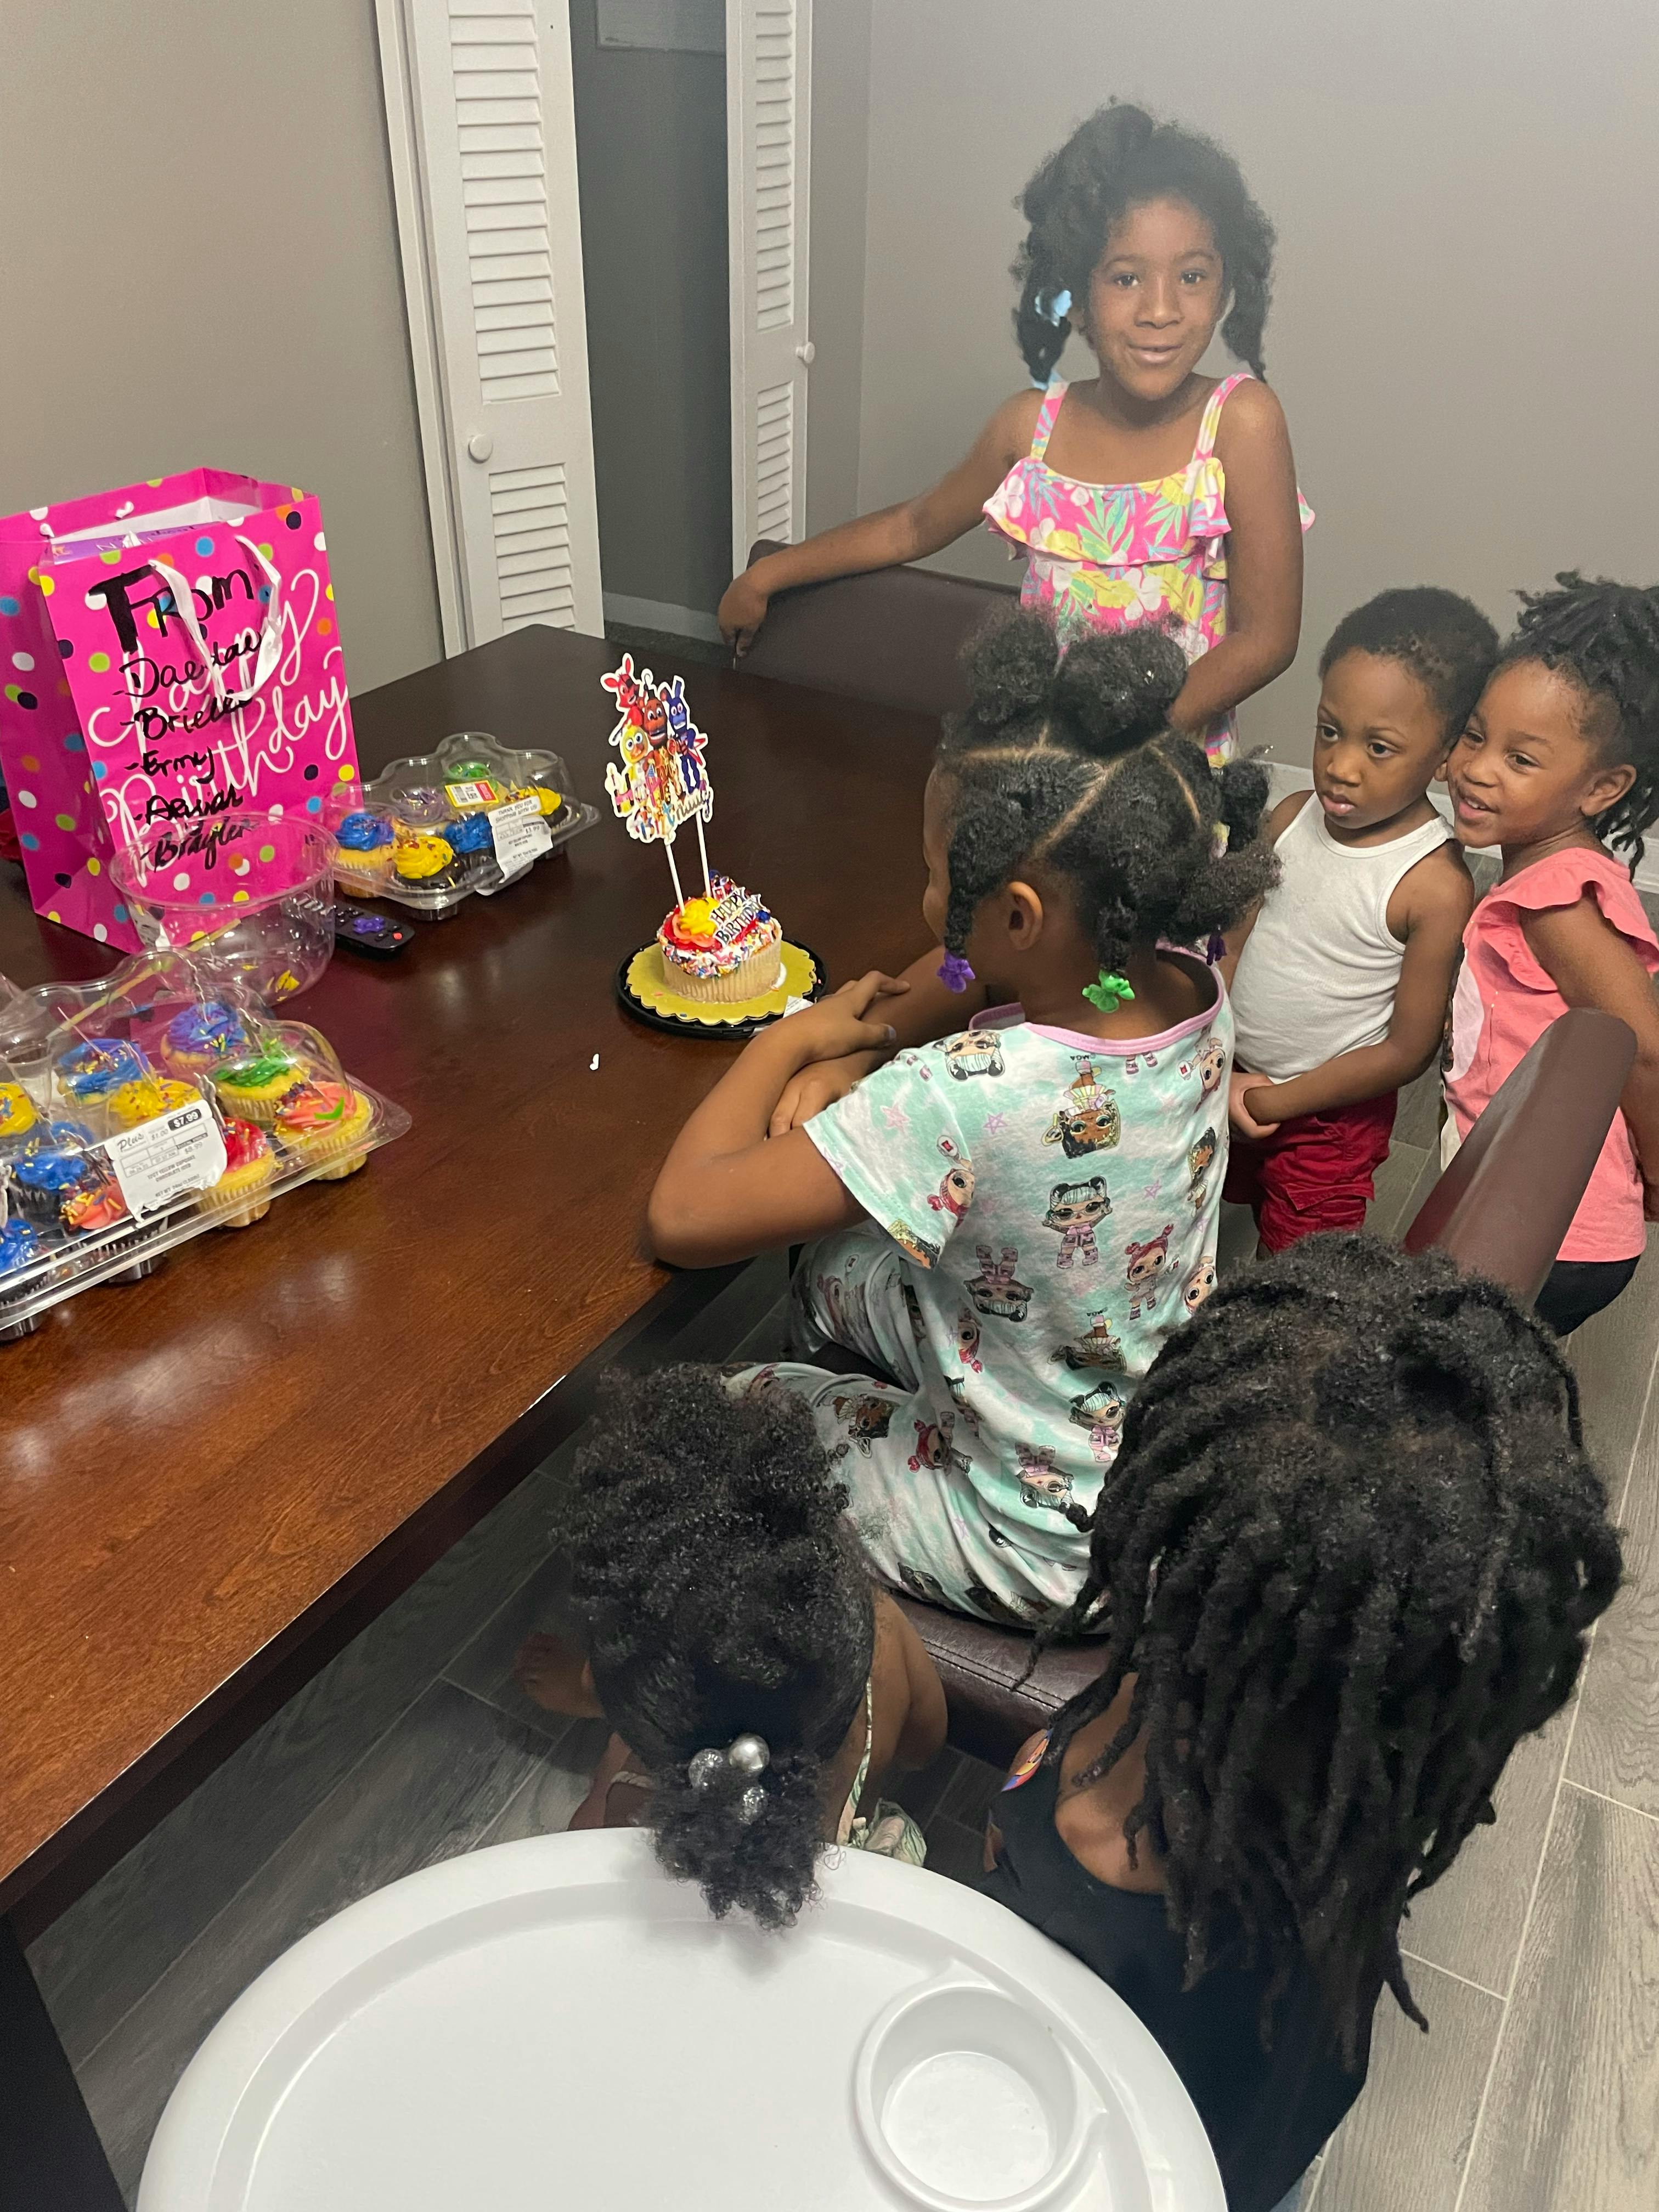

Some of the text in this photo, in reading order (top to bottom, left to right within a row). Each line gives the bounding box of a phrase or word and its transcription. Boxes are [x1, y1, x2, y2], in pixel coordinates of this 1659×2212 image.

[710, 887, 747, 927] HAPPY
[715, 894, 764, 944] BIRTHDAY
[173, 1111, 199, 1128] $7.99
[117, 1132, 145, 1152] Plus
